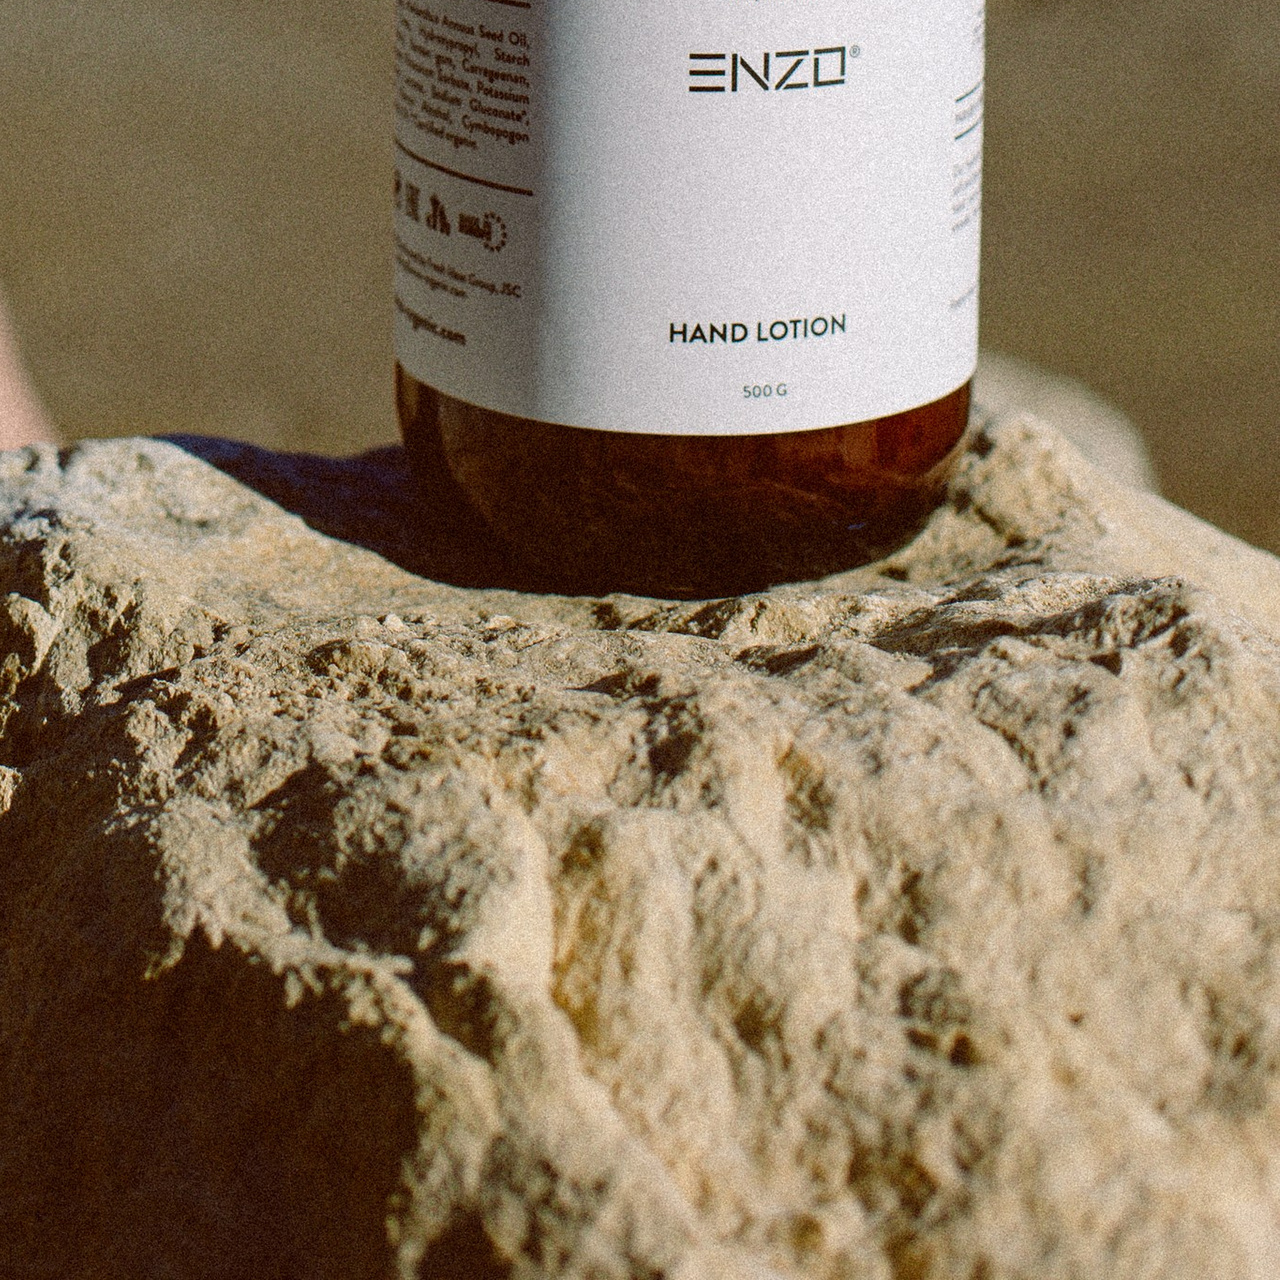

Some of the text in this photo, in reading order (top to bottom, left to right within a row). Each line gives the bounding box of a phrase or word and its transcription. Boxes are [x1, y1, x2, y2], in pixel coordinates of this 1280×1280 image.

[479, 24, 504, 43] Seed
[670, 313, 847, 344] HAND LOTION
[743, 383, 788, 399] 500 G
